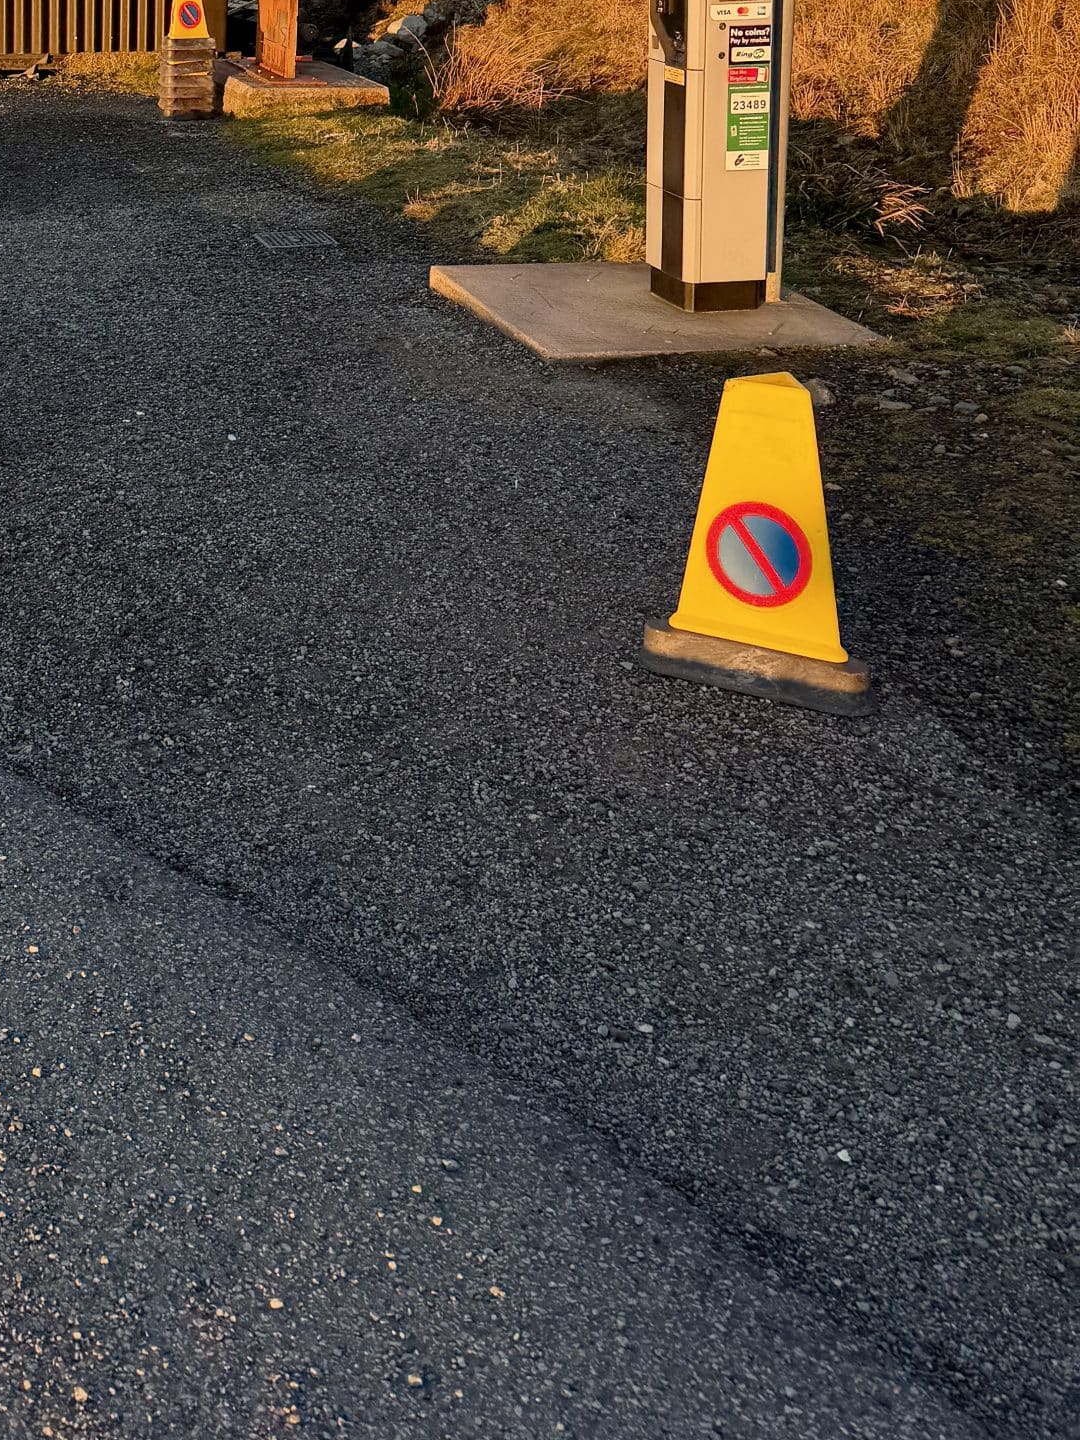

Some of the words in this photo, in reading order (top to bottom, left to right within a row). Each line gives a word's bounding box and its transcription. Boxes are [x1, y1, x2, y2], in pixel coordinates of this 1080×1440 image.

[730, 28, 744, 37] No
[744, 27, 770, 36] coins?
[730, 37, 741, 45] Pay
[741, 37, 750, 45] by
[732, 100, 767, 111] 23489
